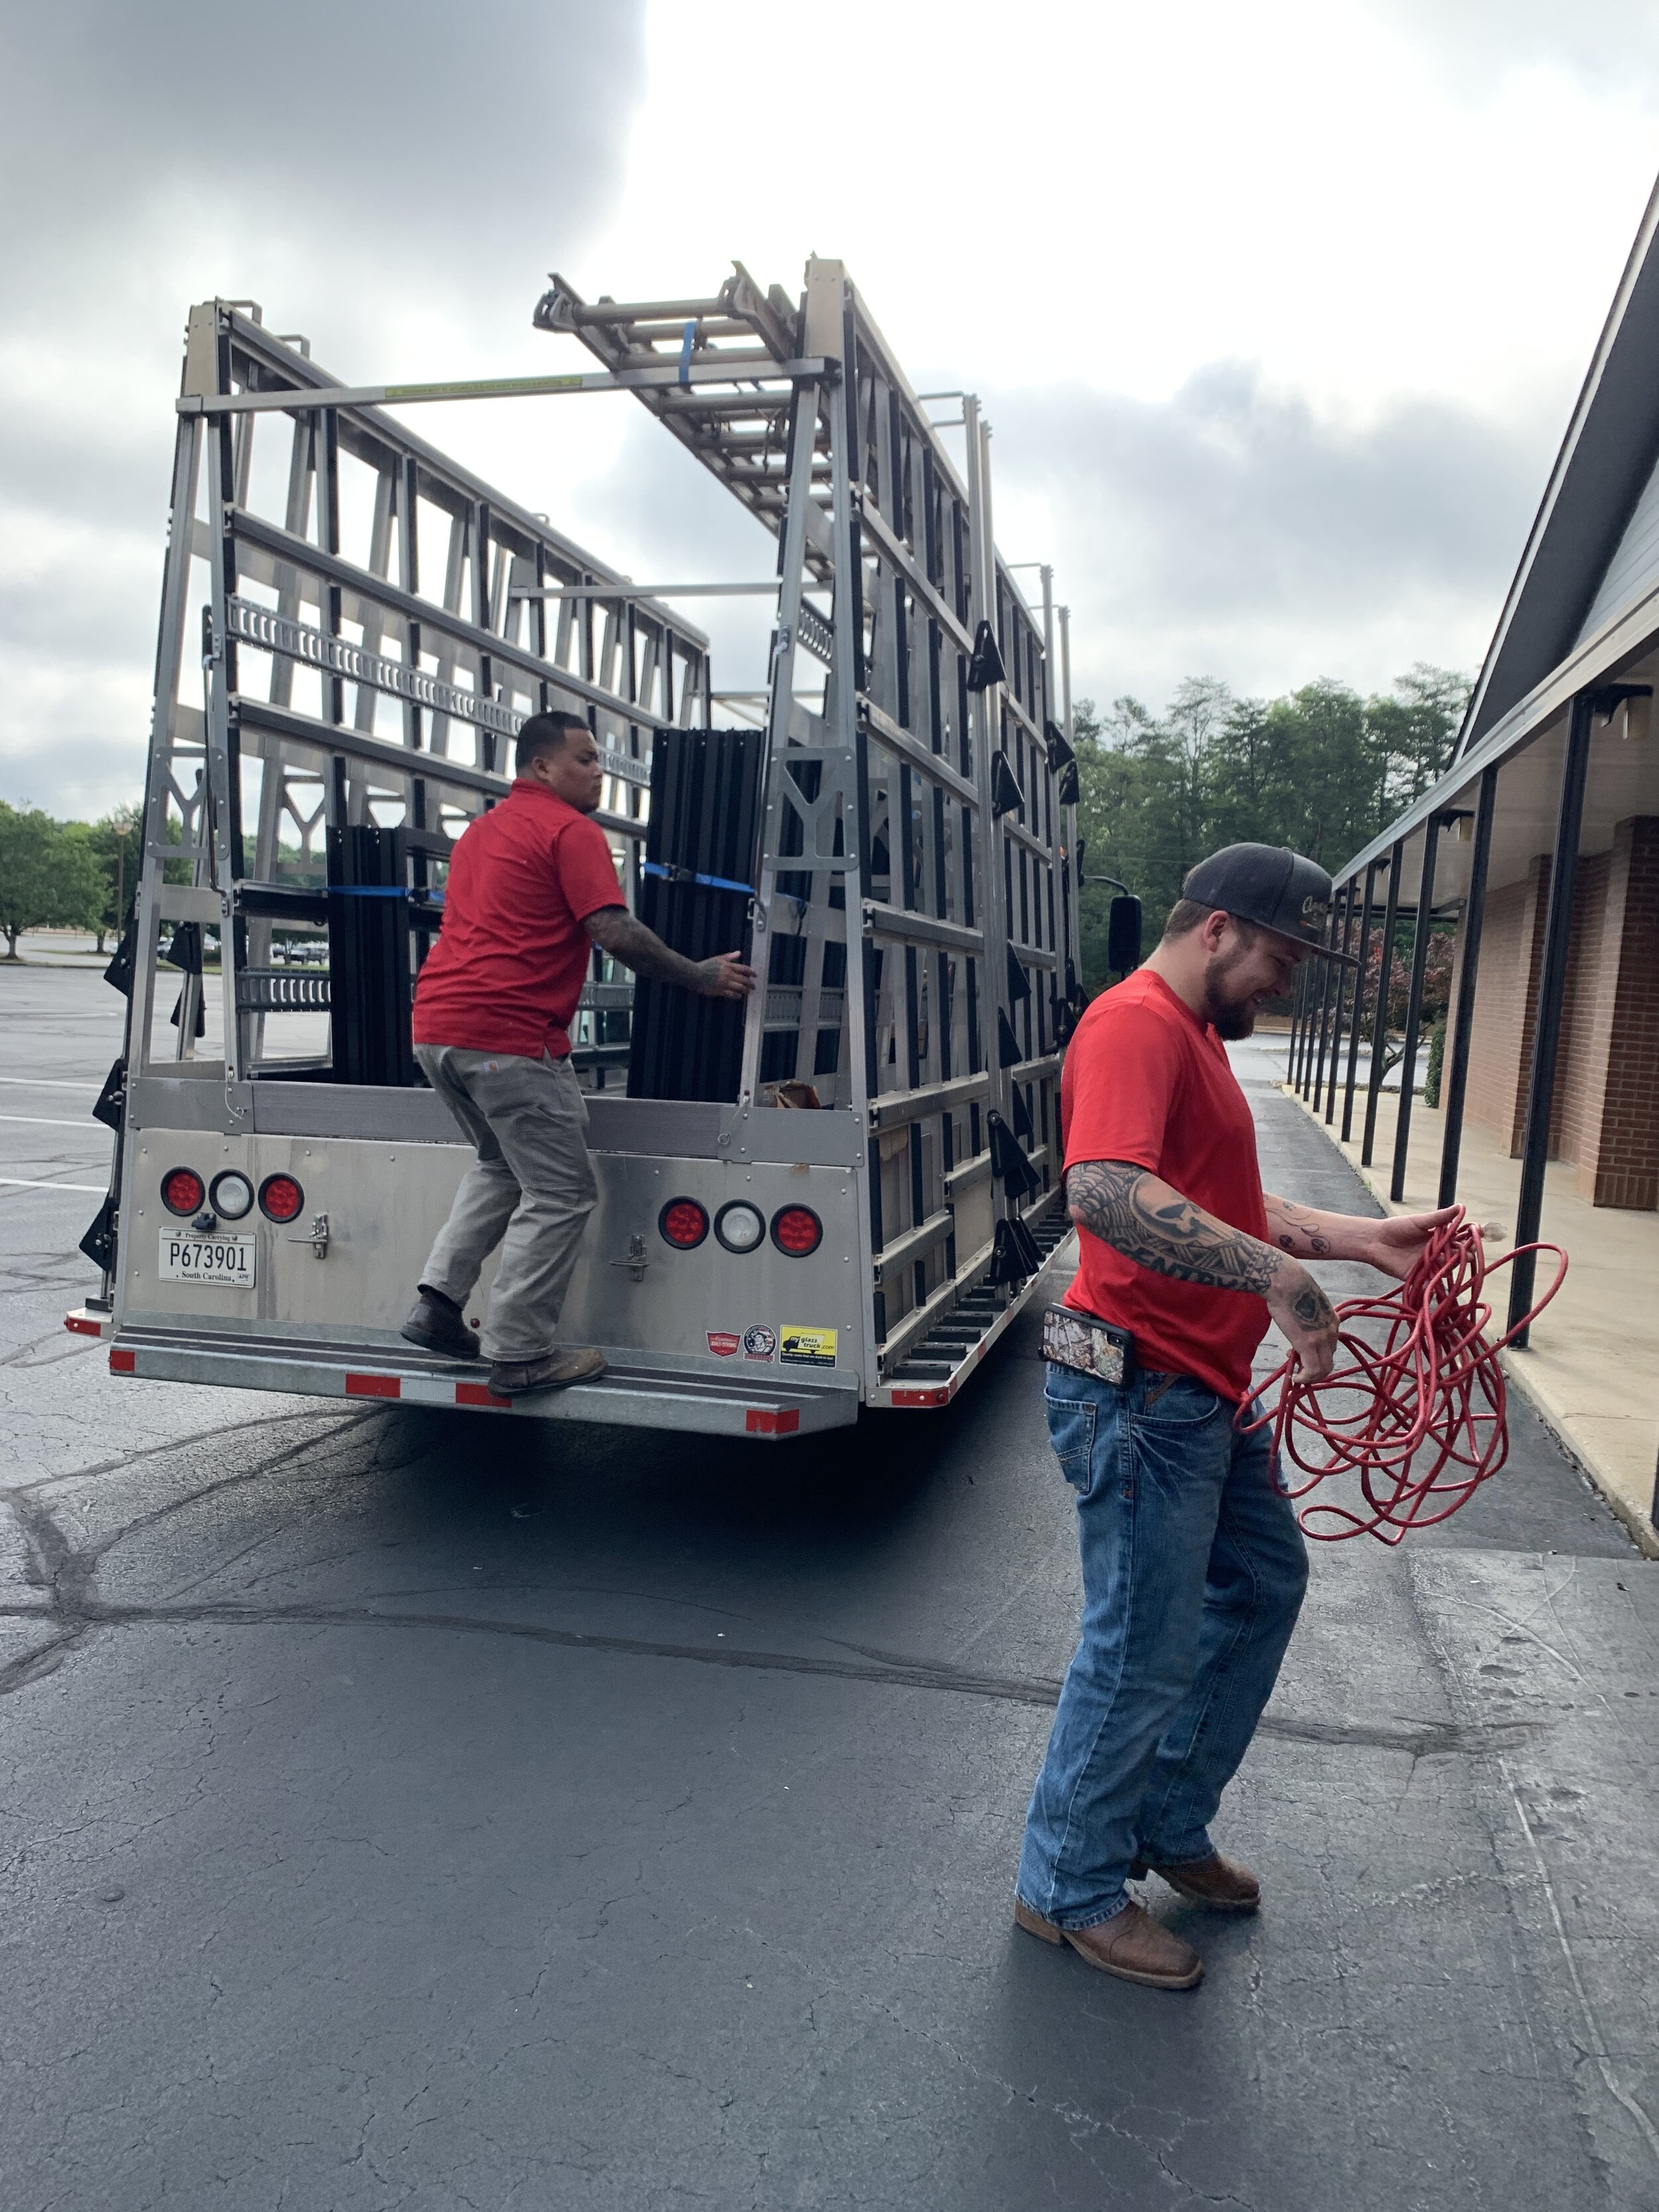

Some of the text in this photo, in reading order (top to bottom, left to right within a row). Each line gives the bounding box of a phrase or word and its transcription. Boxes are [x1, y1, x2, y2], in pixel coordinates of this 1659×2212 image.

[170, 1242, 247, 1272] P673901
[181, 1270, 232, 1282] South Carolina
